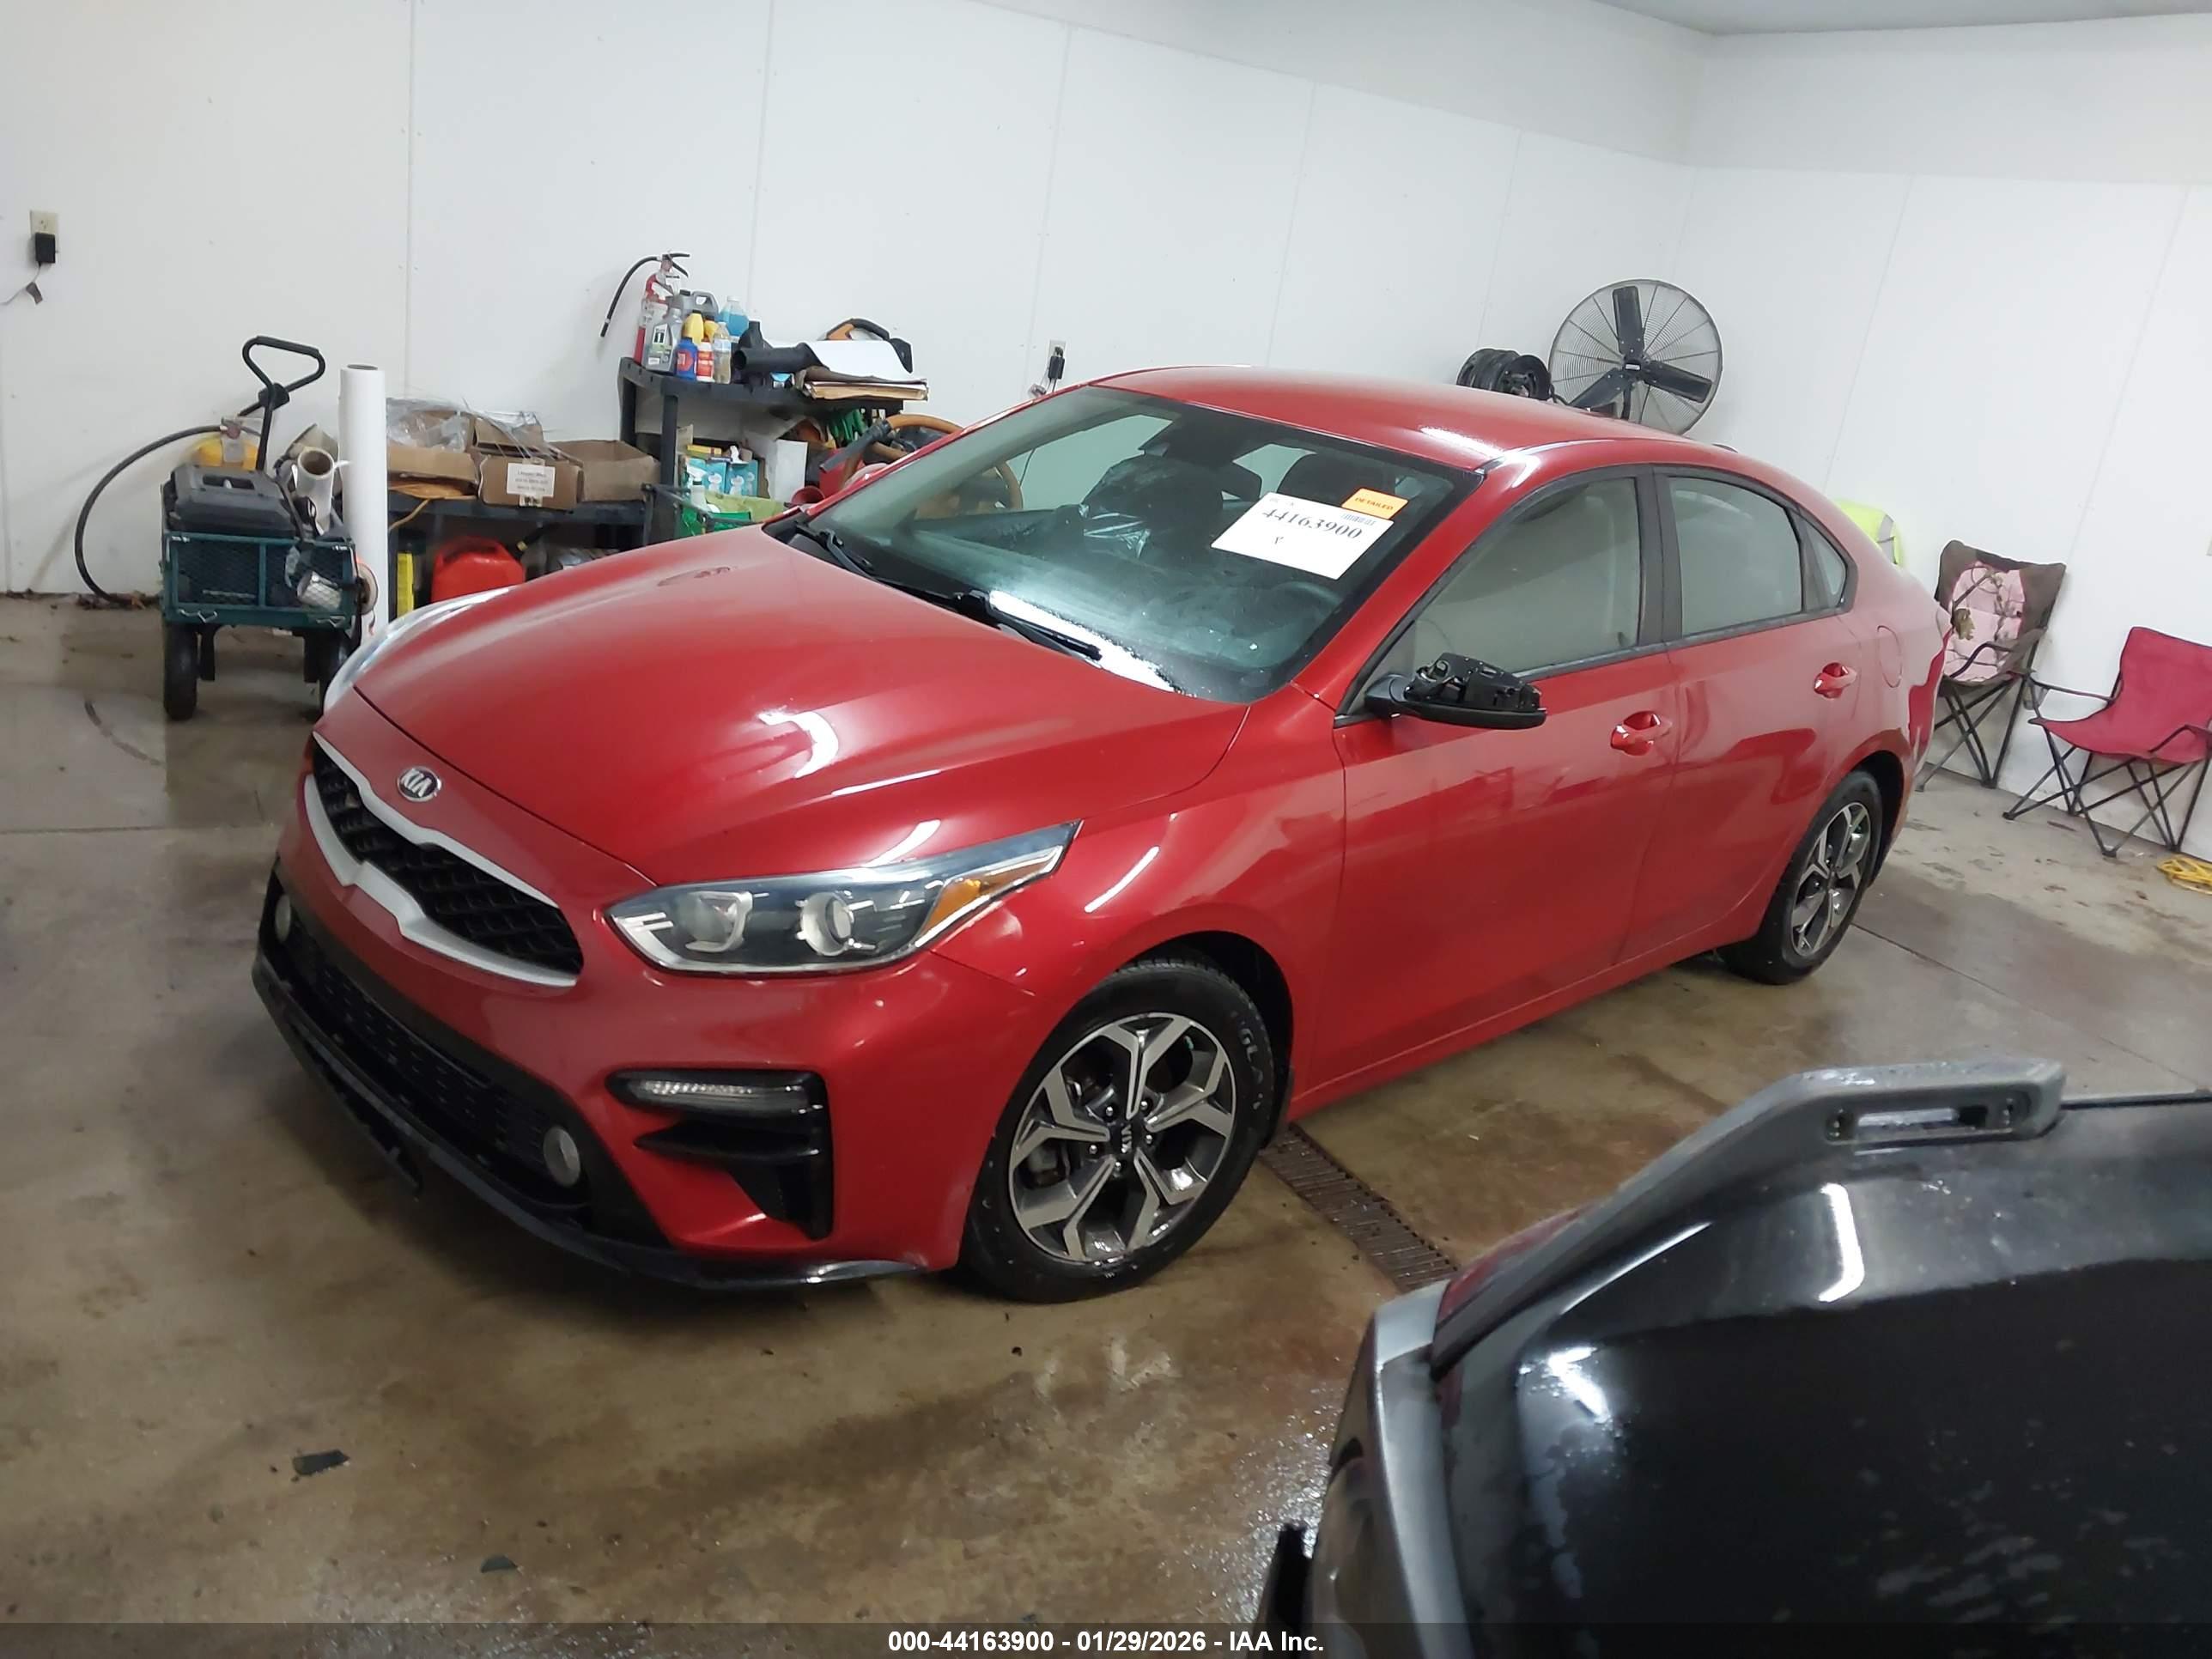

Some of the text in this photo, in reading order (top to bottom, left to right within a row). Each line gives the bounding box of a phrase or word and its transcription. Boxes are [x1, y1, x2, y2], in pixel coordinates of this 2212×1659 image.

[1354, 496, 1394, 511] DETAILED
[1262, 508, 1363, 539] 44163900
[400, 768, 433, 798] KIA
